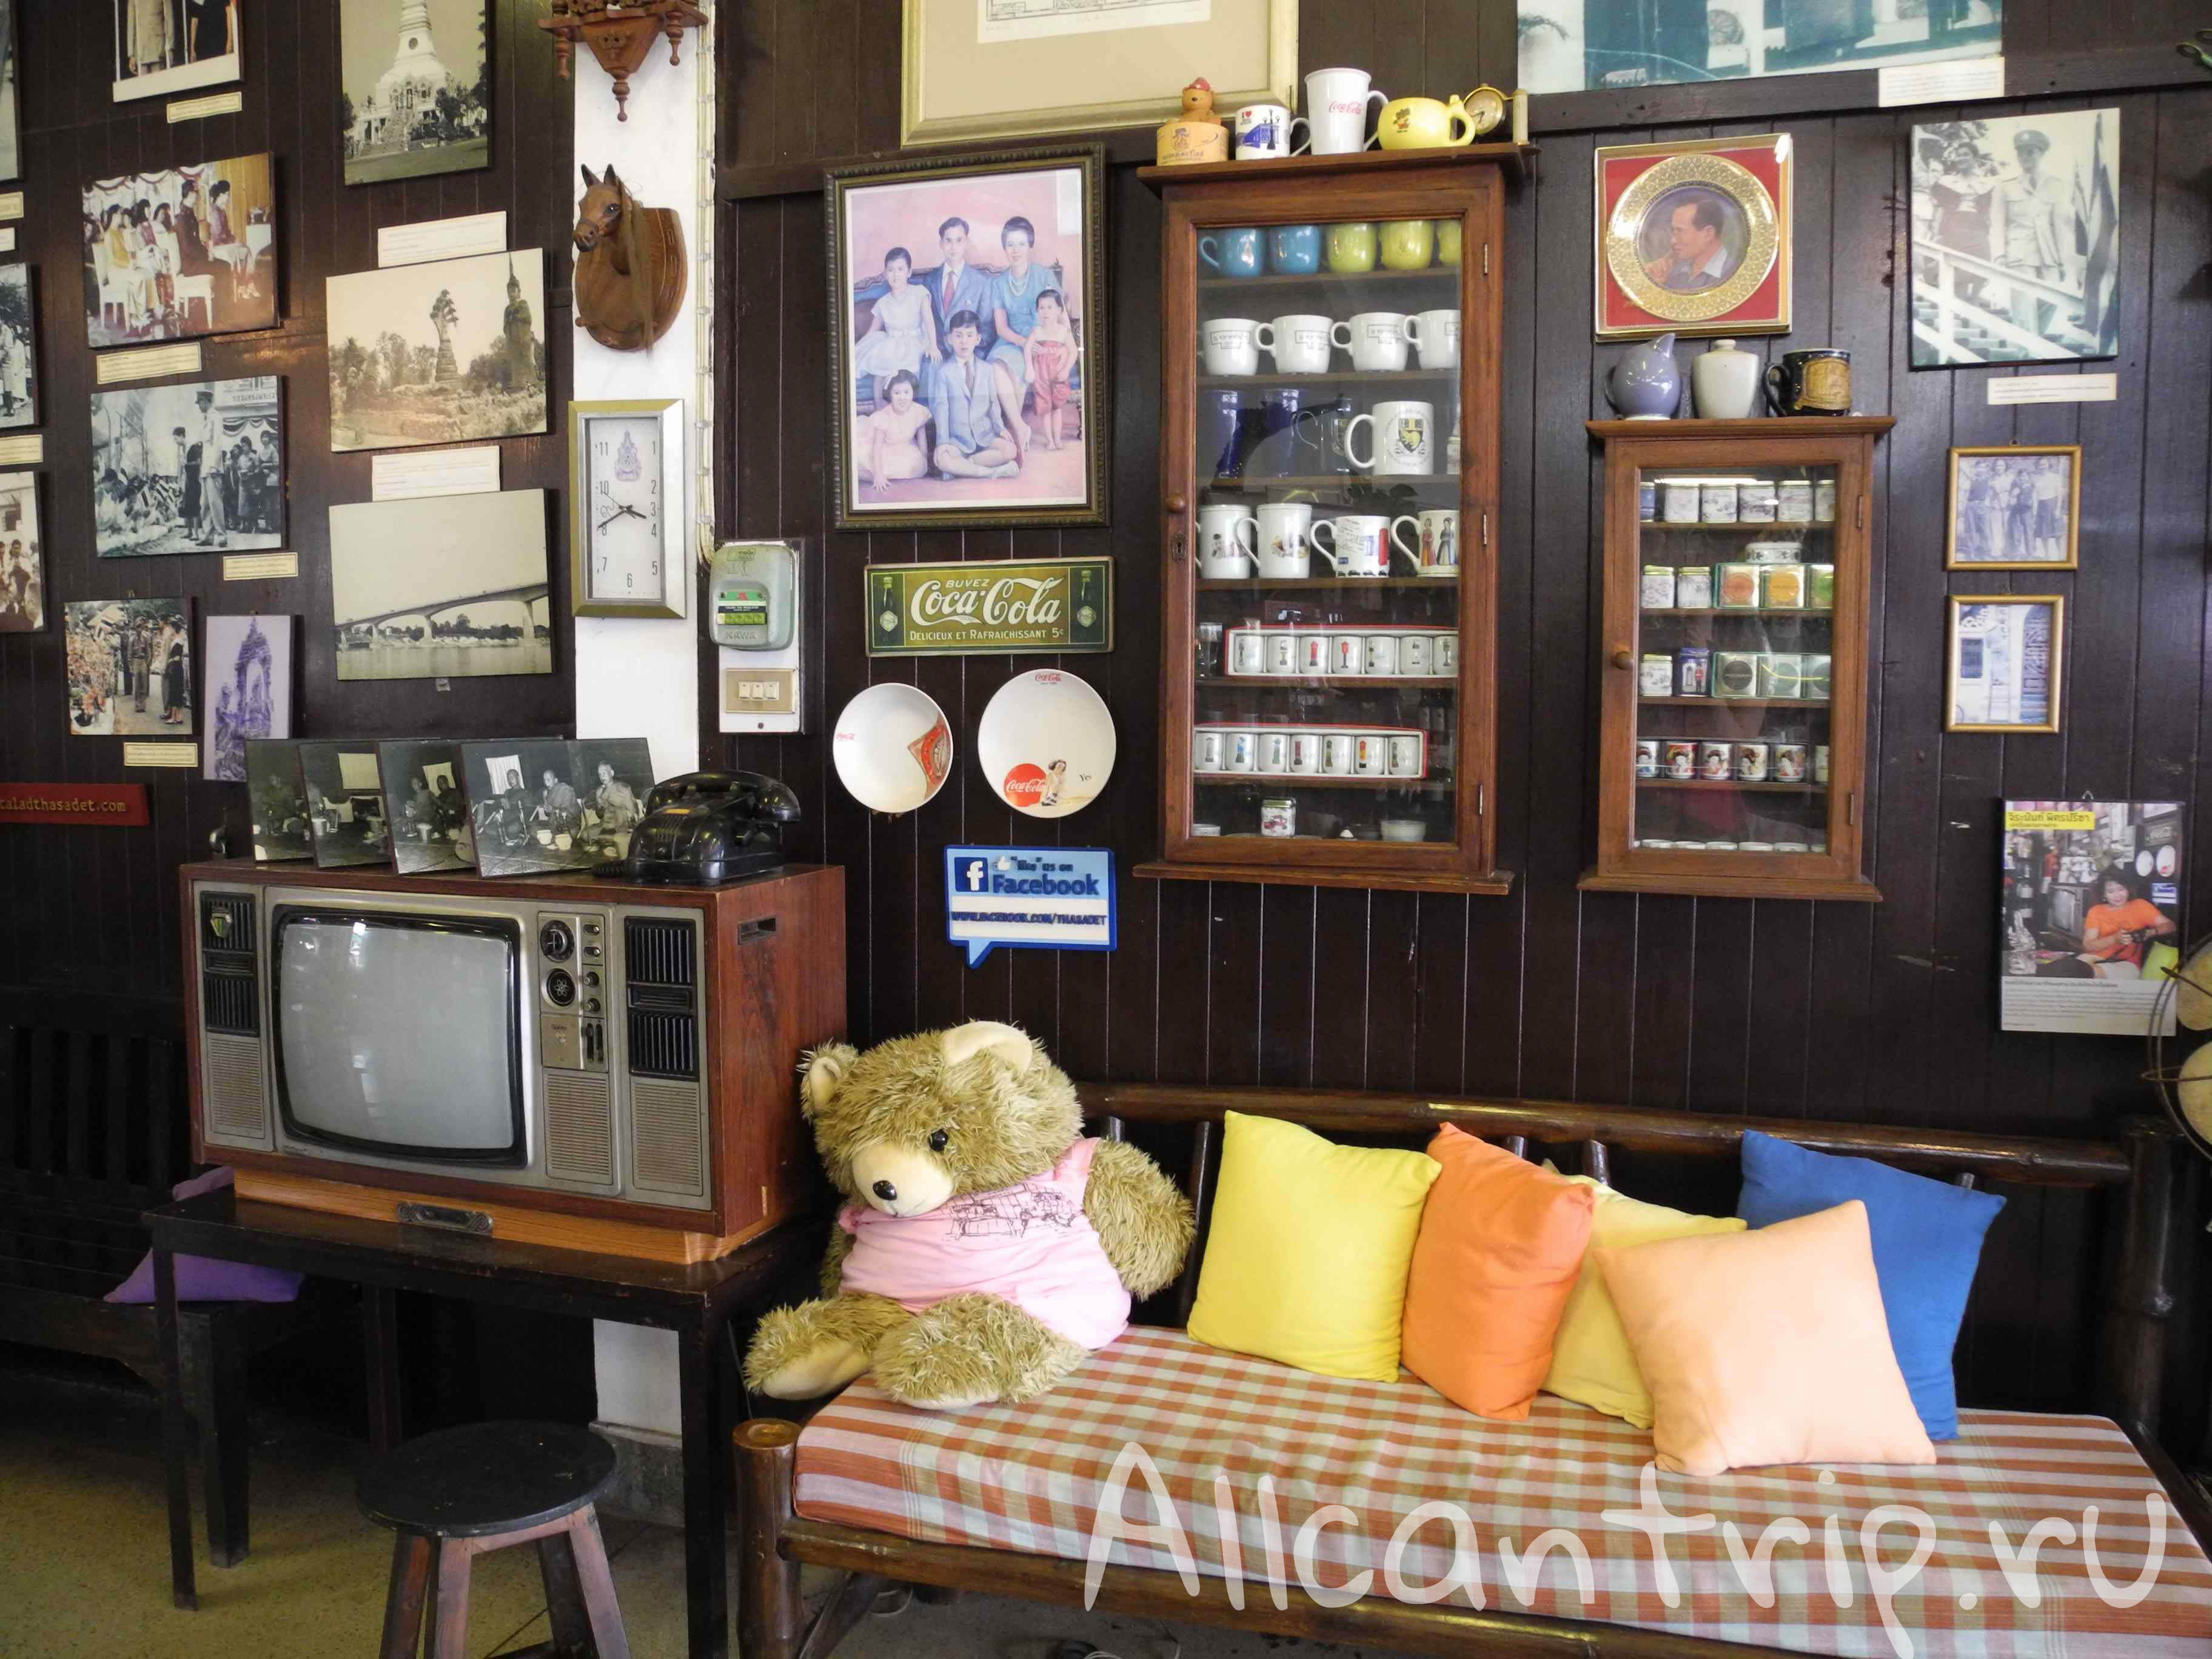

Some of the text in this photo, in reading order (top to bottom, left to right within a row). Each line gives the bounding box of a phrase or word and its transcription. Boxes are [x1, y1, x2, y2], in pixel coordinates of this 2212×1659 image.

[598, 441, 608, 456] 11
[652, 441, 655, 455] 1
[600, 480, 609, 495] 10
[651, 480, 656, 495] 2
[651, 501, 656, 517] 3
[651, 523, 657, 538] 4
[602, 557, 608, 572] 7
[652, 561, 658, 575] 5
[627, 573, 632, 588] 6
[945, 578, 990, 588] BUVEZ
[911, 577, 1064, 626] Coca-Cola
[956, 631, 967, 640] ET
[1042, 863, 1055, 871] us
[1059, 863, 1073, 872] on
[967, 860, 984, 891] f
[992, 873, 1100, 896] Facebook
